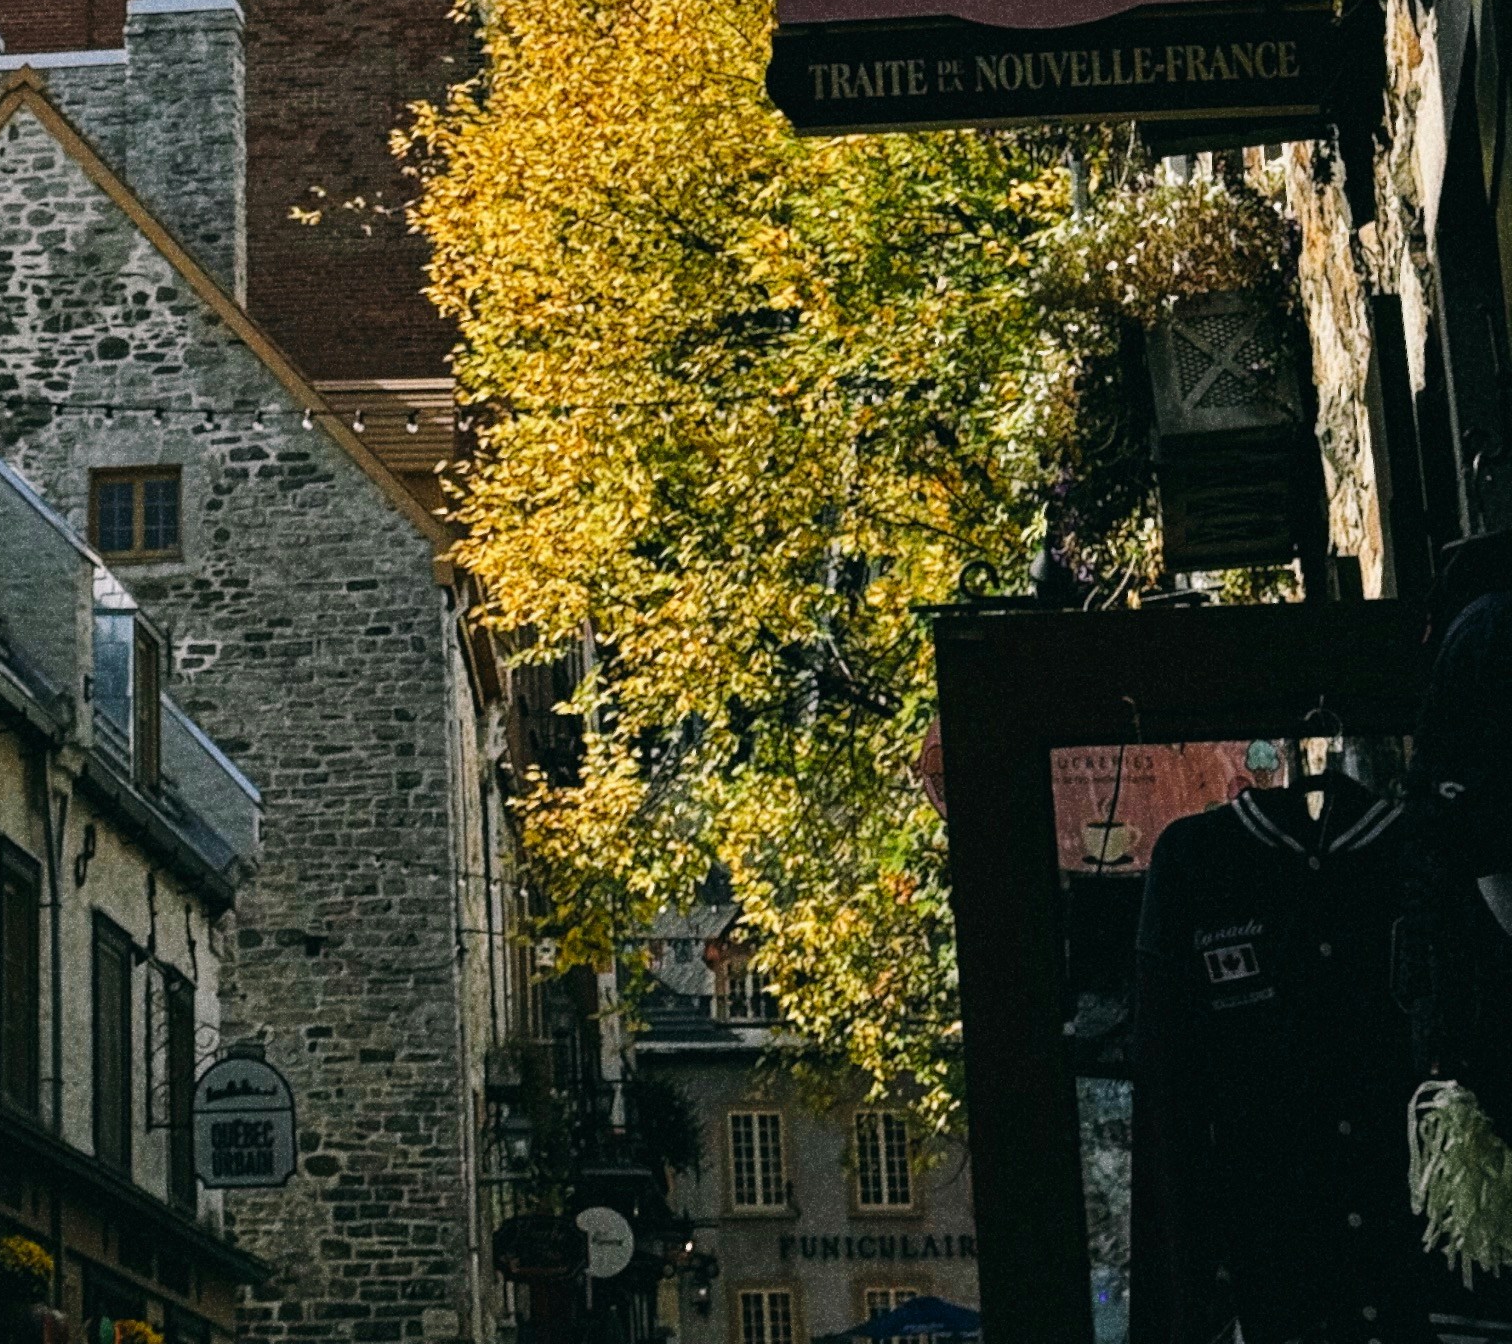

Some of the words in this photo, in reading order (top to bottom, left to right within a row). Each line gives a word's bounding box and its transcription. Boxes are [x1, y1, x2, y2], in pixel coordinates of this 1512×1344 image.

[808, 58, 928, 101] TRAITE
[937, 60, 965, 76] DE
[974, 40, 1300, 93] NOUVELLE-FRANCE
[937, 75, 965, 93] LA
[1193, 917, 1264, 950] Canada
